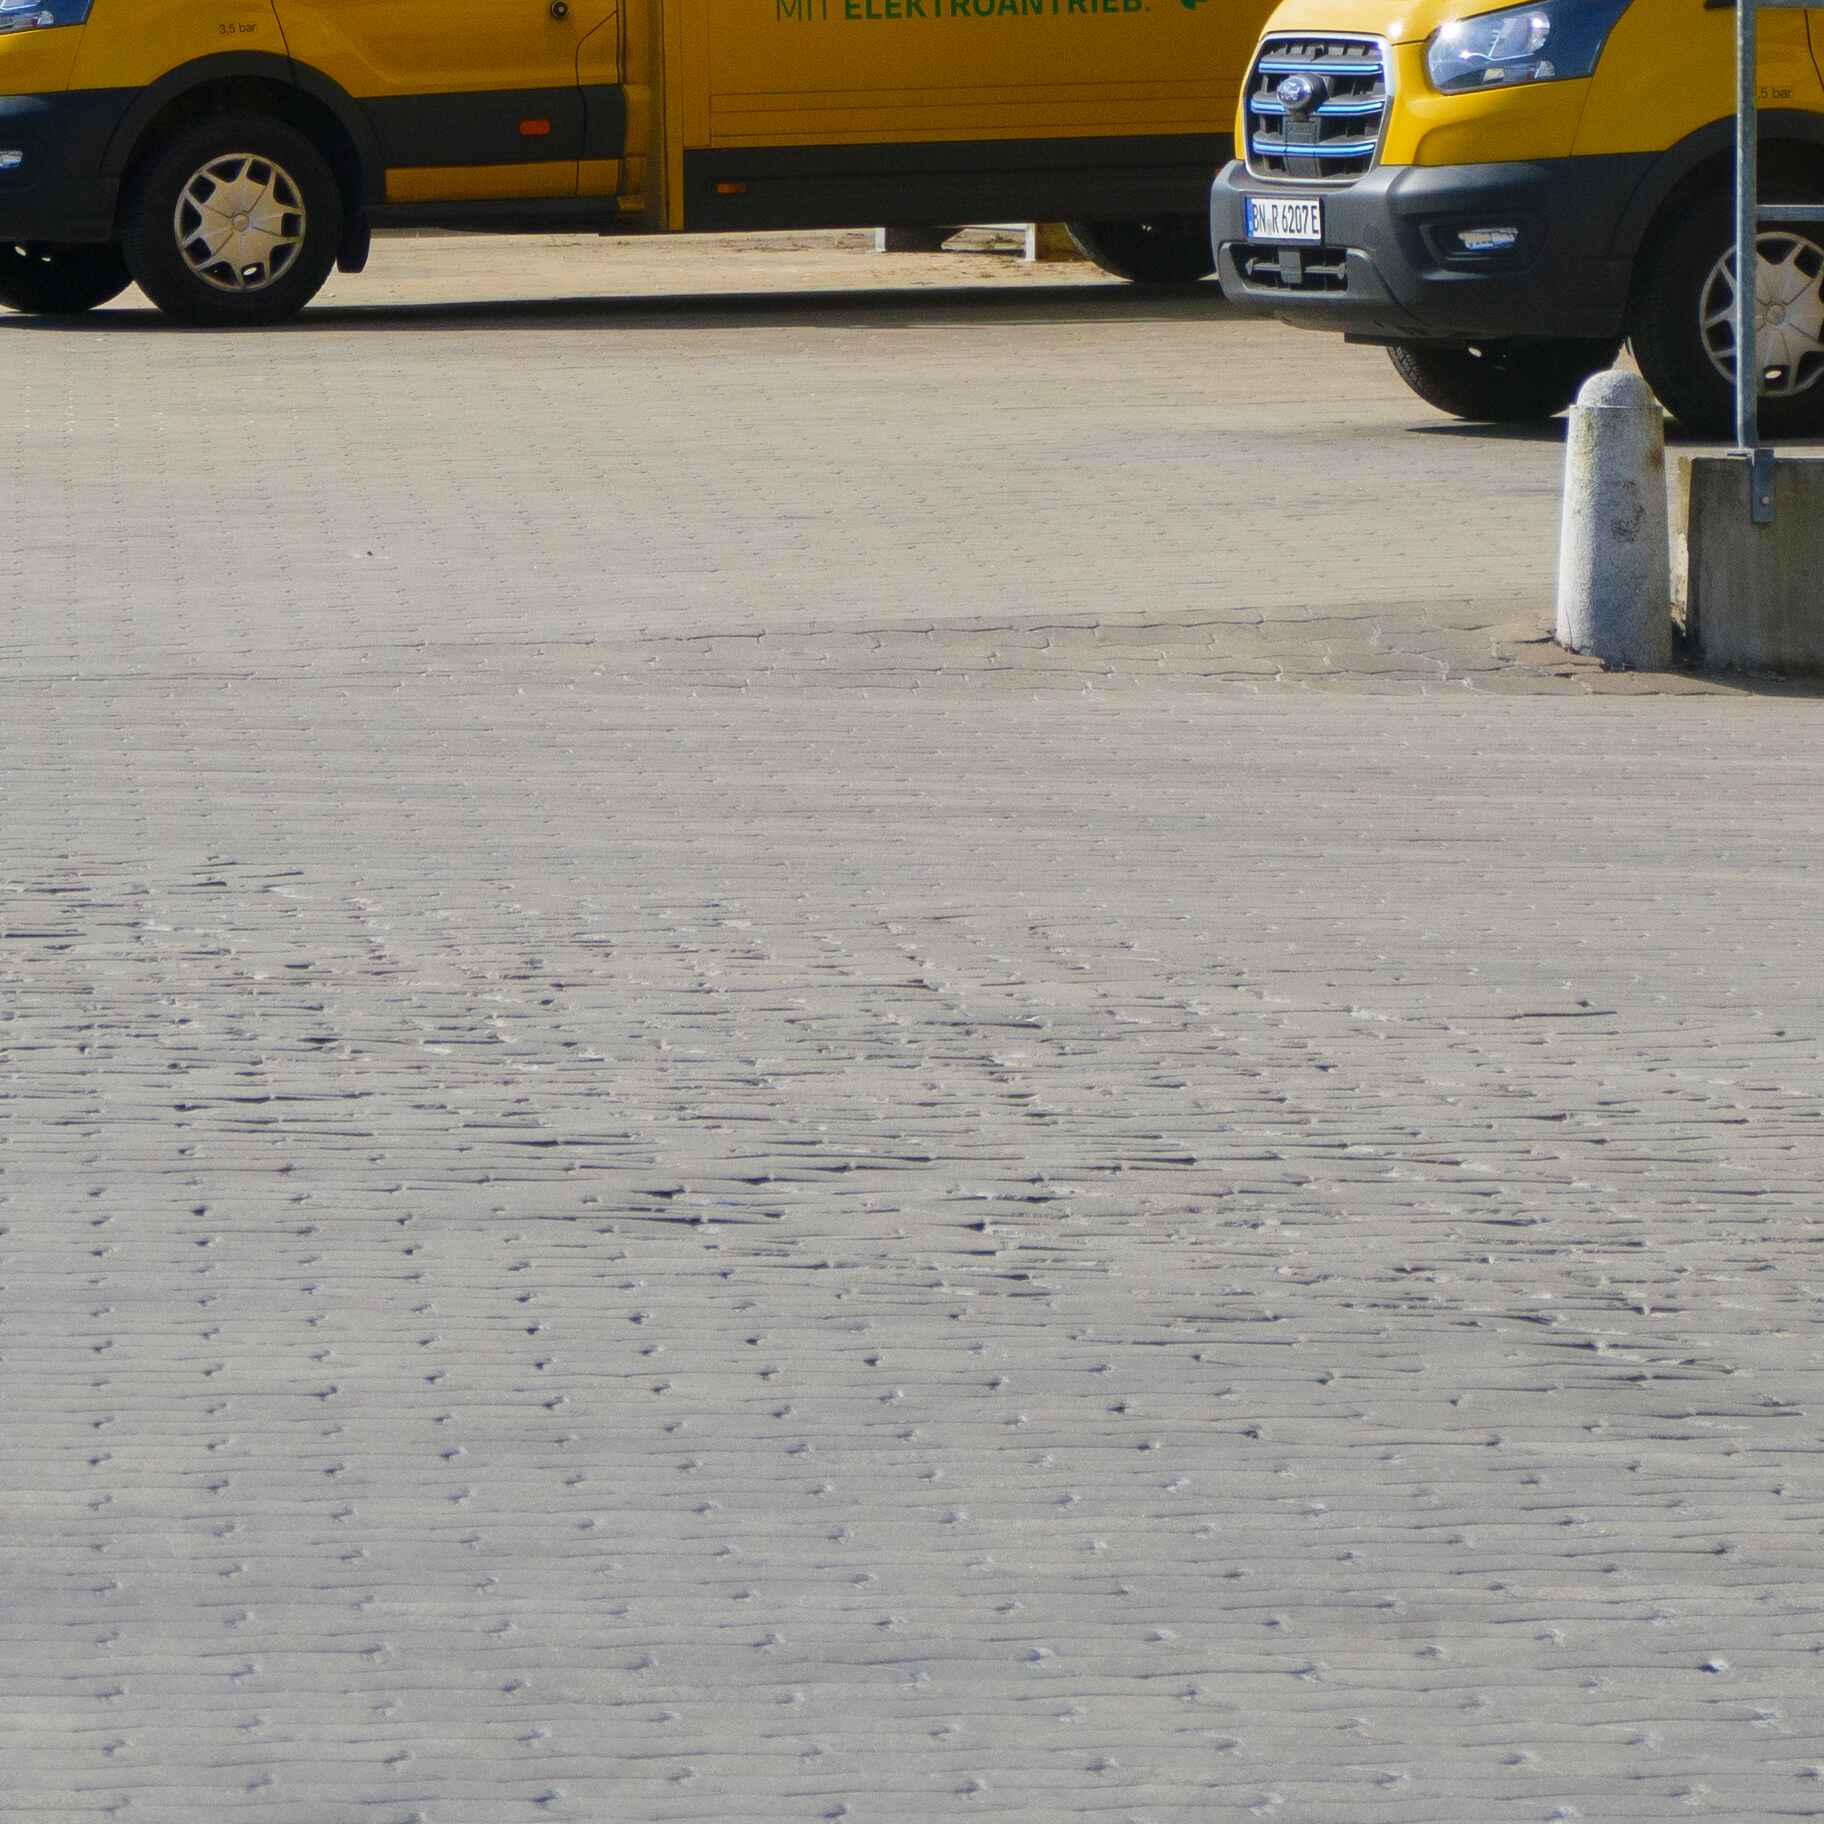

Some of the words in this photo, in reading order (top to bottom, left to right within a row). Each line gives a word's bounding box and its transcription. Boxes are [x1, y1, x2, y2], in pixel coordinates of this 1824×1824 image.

[238, 22, 257, 33] bar
[1251, 203, 1266, 232] BN
[1272, 204, 1279, 233] R
